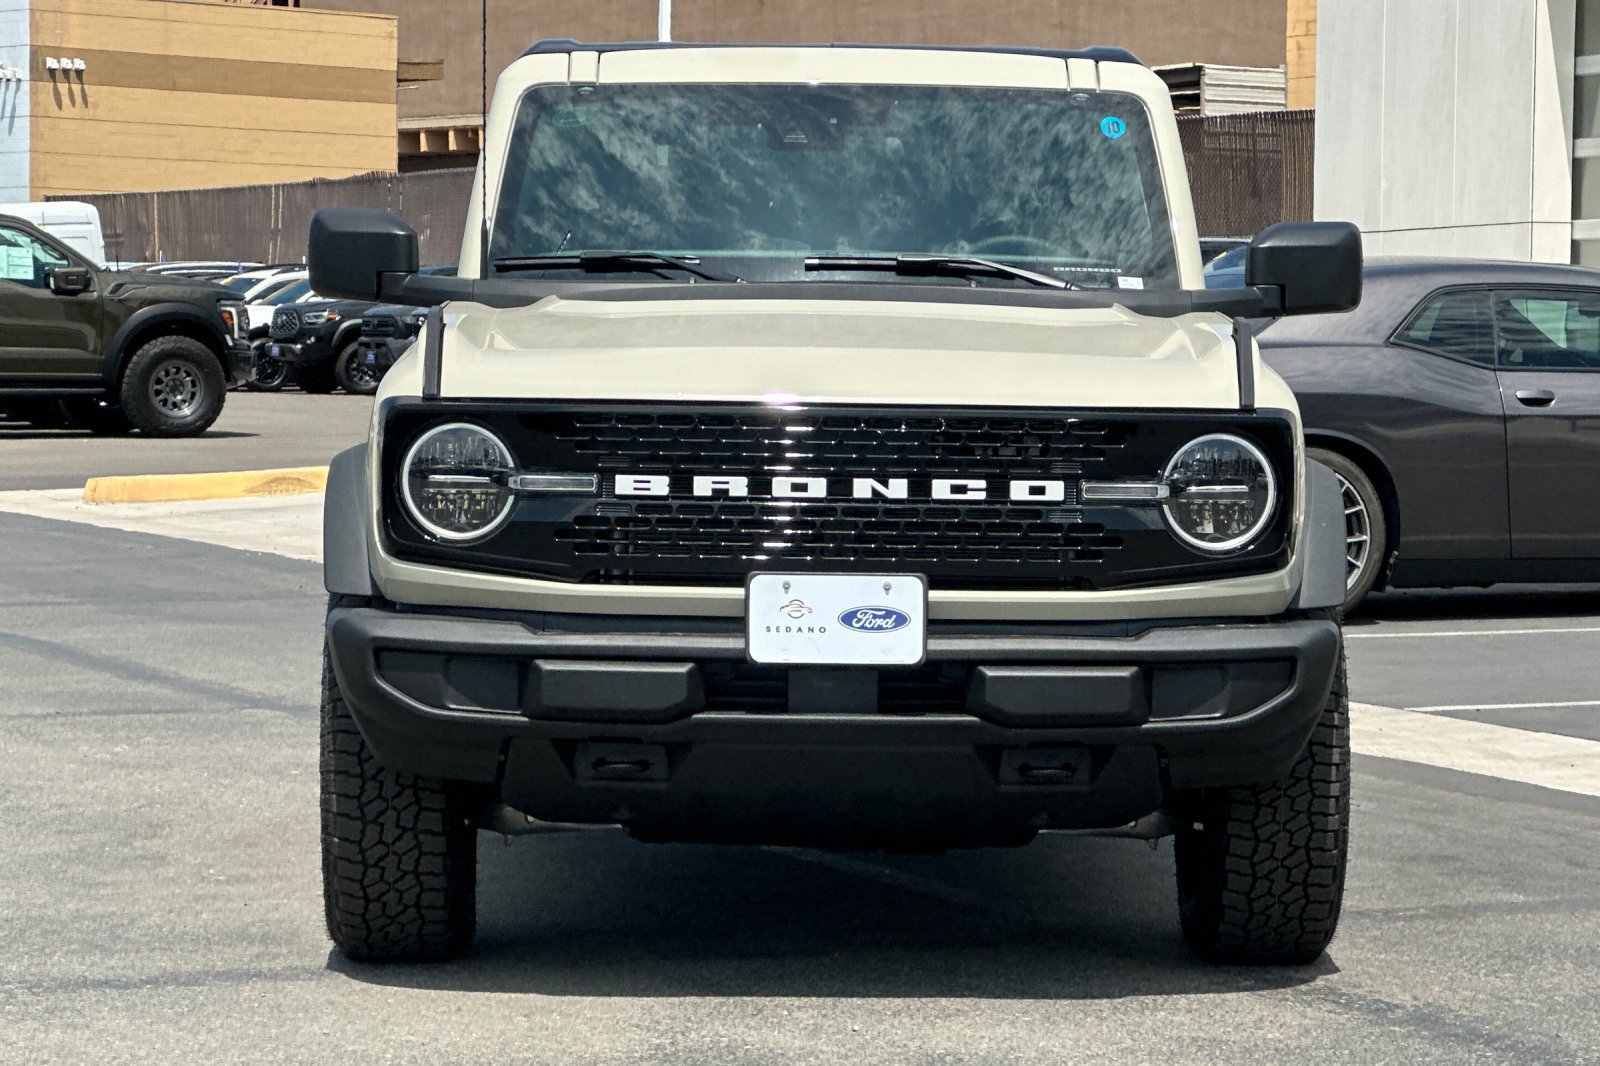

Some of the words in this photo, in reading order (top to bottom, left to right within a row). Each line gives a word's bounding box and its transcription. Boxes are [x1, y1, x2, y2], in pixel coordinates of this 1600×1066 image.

[614, 474, 1065, 500] BRONCO
[851, 608, 897, 629] Ford
[765, 625, 826, 634] SEDANO
